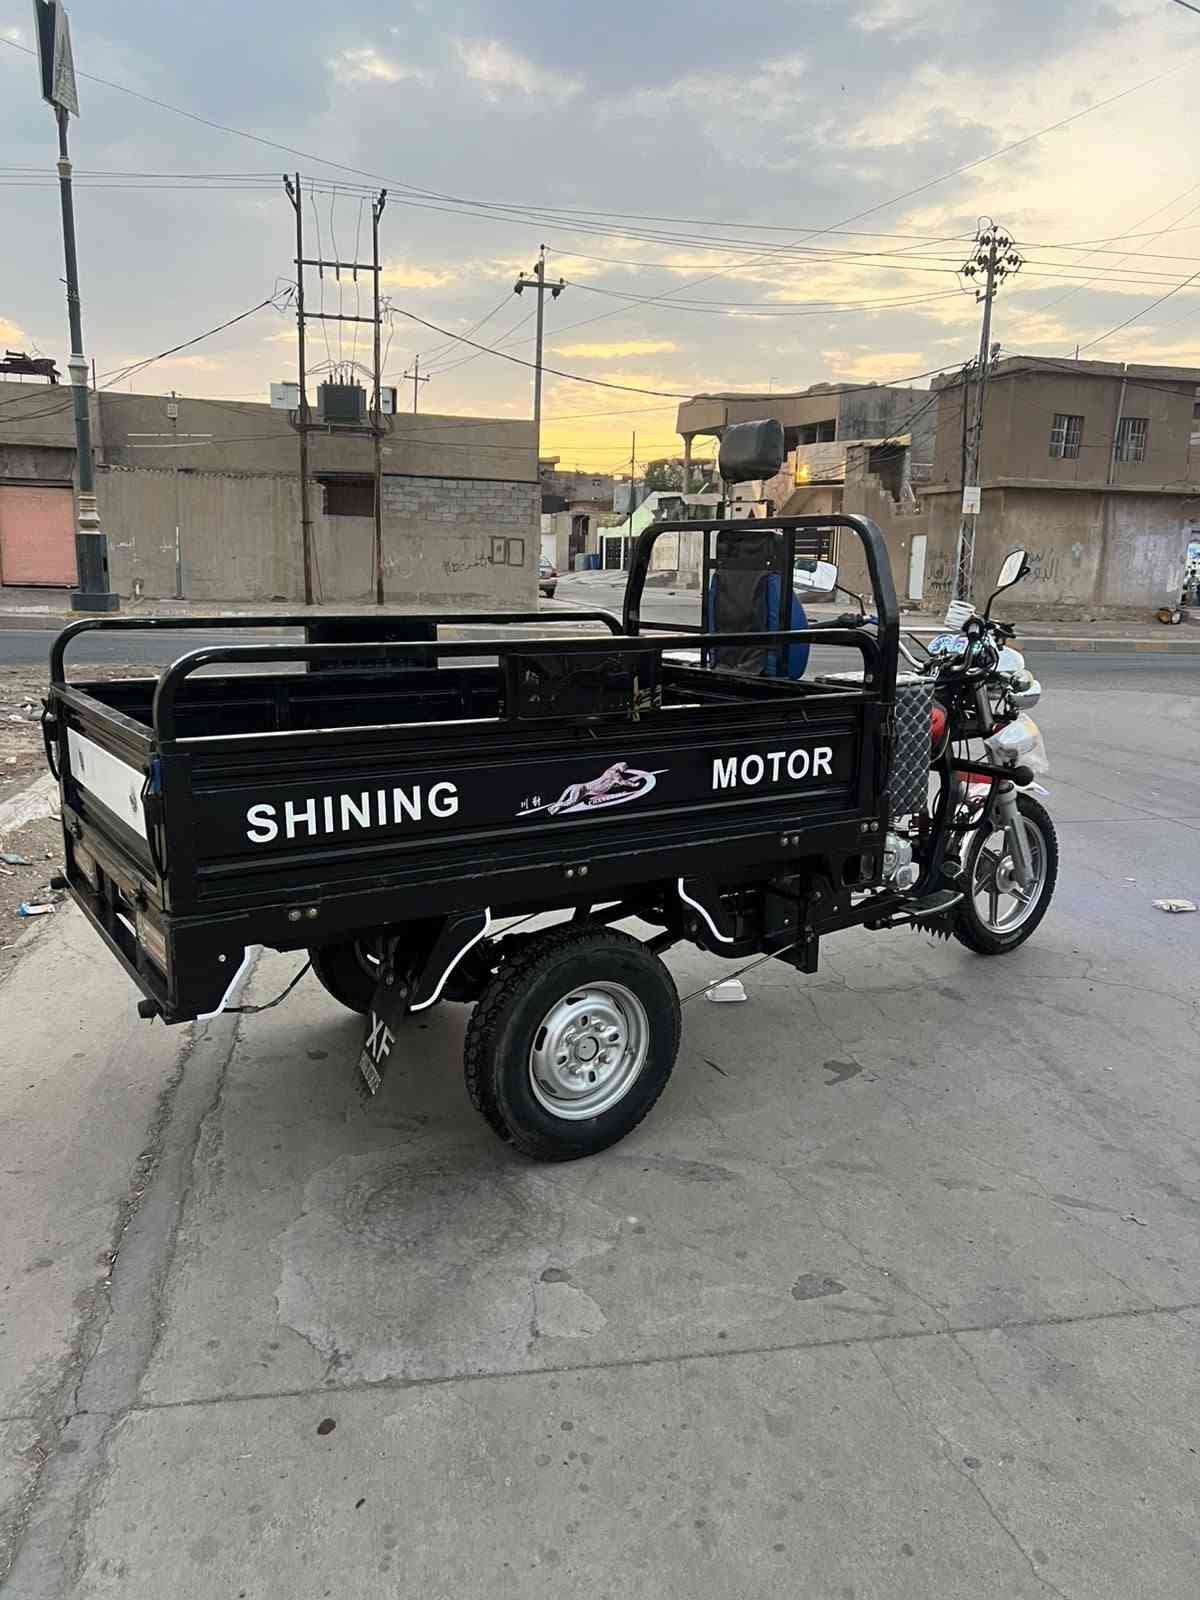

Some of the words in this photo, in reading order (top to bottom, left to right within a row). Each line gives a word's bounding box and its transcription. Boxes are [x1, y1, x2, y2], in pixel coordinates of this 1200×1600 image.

[246, 781, 459, 843] SHINING
[711, 746, 834, 790] MOTOR
[365, 1010, 396, 1063] XF
